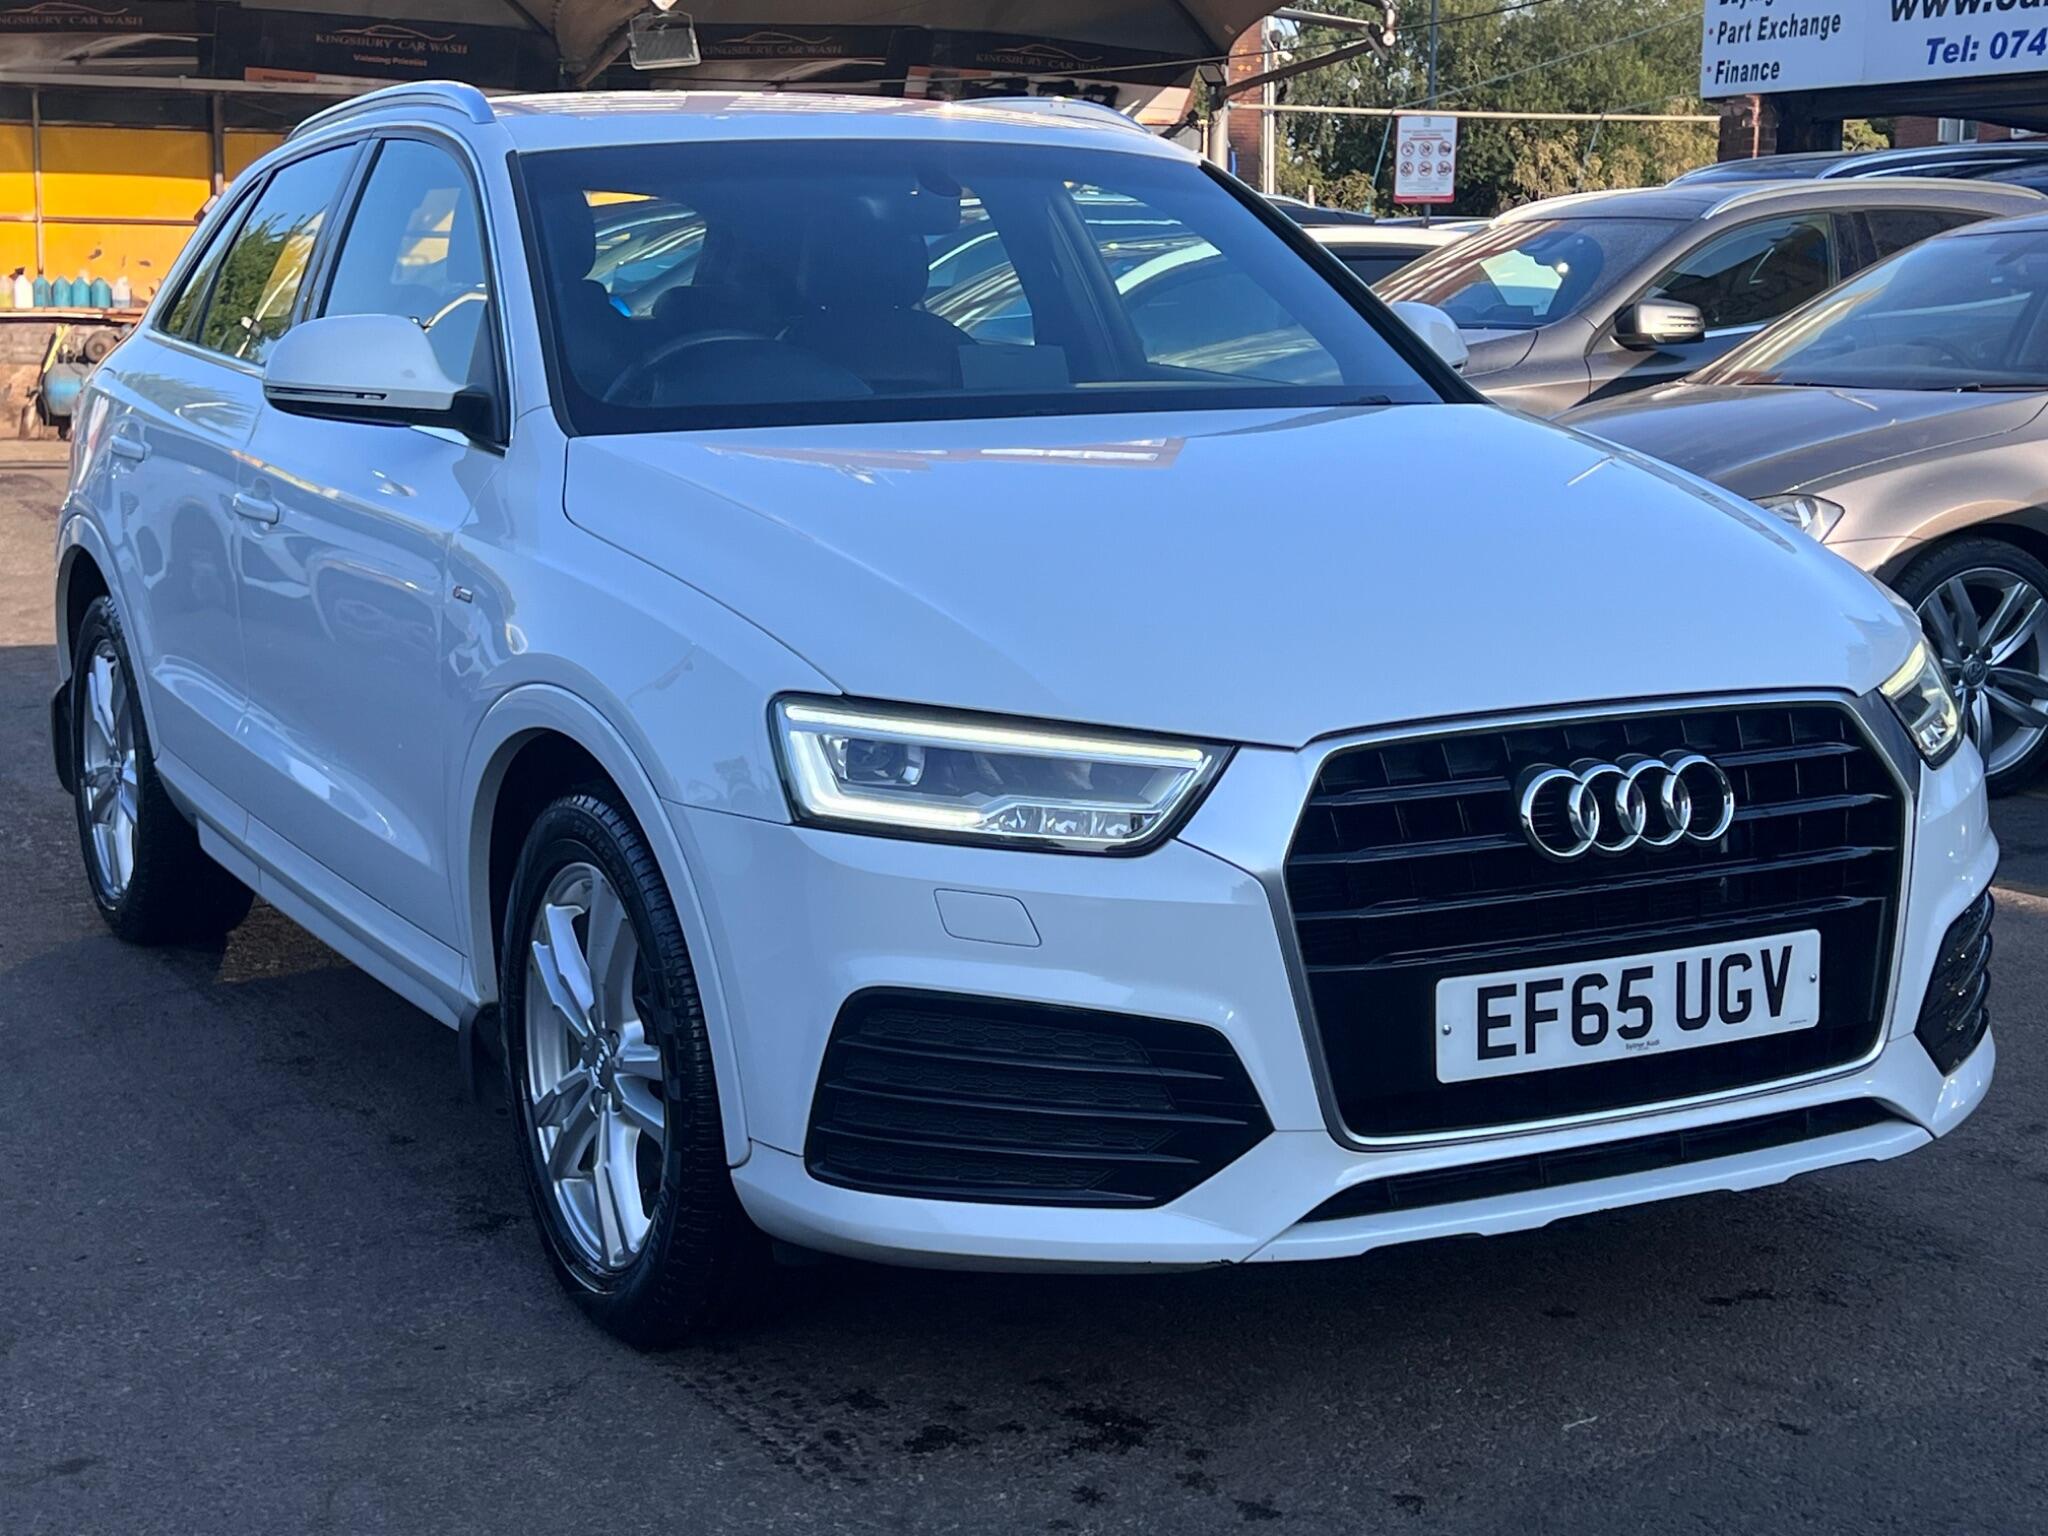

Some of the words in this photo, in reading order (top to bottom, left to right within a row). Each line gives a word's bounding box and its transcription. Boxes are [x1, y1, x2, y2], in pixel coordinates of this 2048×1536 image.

[69, 15, 98, 25] CAR
[103, 15, 144, 25] WASH
[1717, 19, 1752, 45] Part
[1757, 13, 1841, 41] Exchange
[315, 34, 392, 49] KINGSBURY
[398, 40, 426, 51] CAR
[429, 42, 468, 55] WASH
[1926, 34, 1980, 65] Tel:
[1047, 60, 1074, 70] CAR
[1715, 60, 1780, 85] Finance
[1477, 965, 1654, 1060] EF65
[1675, 945, 1793, 1032] UGV
